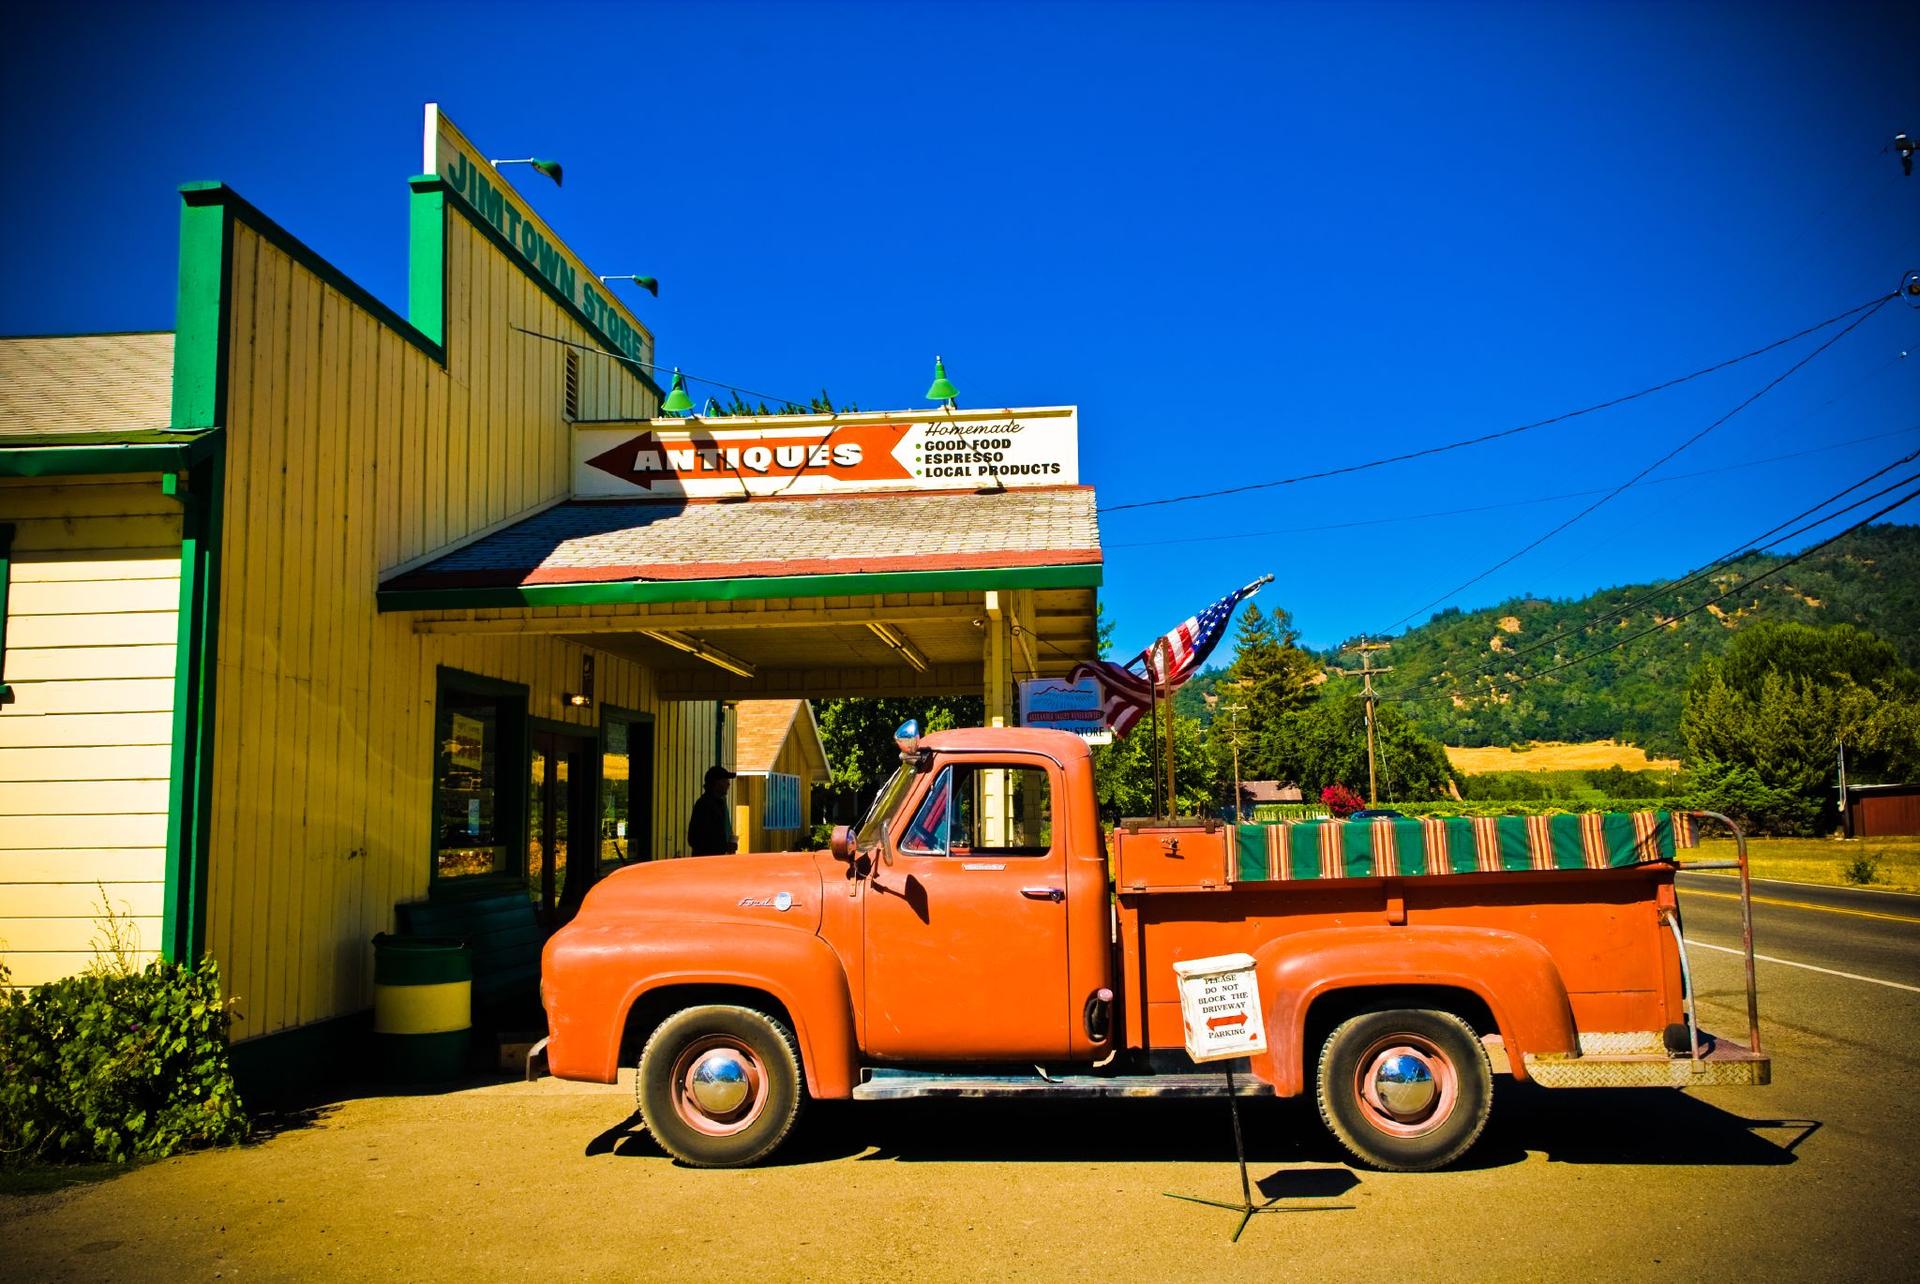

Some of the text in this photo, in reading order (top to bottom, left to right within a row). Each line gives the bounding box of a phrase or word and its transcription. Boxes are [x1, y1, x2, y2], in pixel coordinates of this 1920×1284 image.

[448, 151, 643, 362] JIMTOWN STORE
[925, 421, 1025, 437] Homemade
[925, 438, 1012, 451] GOOD FOOD
[632, 443, 864, 473] ANTIQUES
[925, 452, 1004, 464] ESPRESSO
[925, 463, 1061, 478] LOCAL PRODUCTS
[1075, 727, 1104, 737] STORE
[1205, 975, 1236, 984] PLEASE
[1222, 984, 1238, 992] NOT
[1198, 992, 1248, 1005] BLOCK THE
[1202, 1002, 1245, 1013] DRIVEWAY
[1208, 1028, 1245, 1038] PARKING
